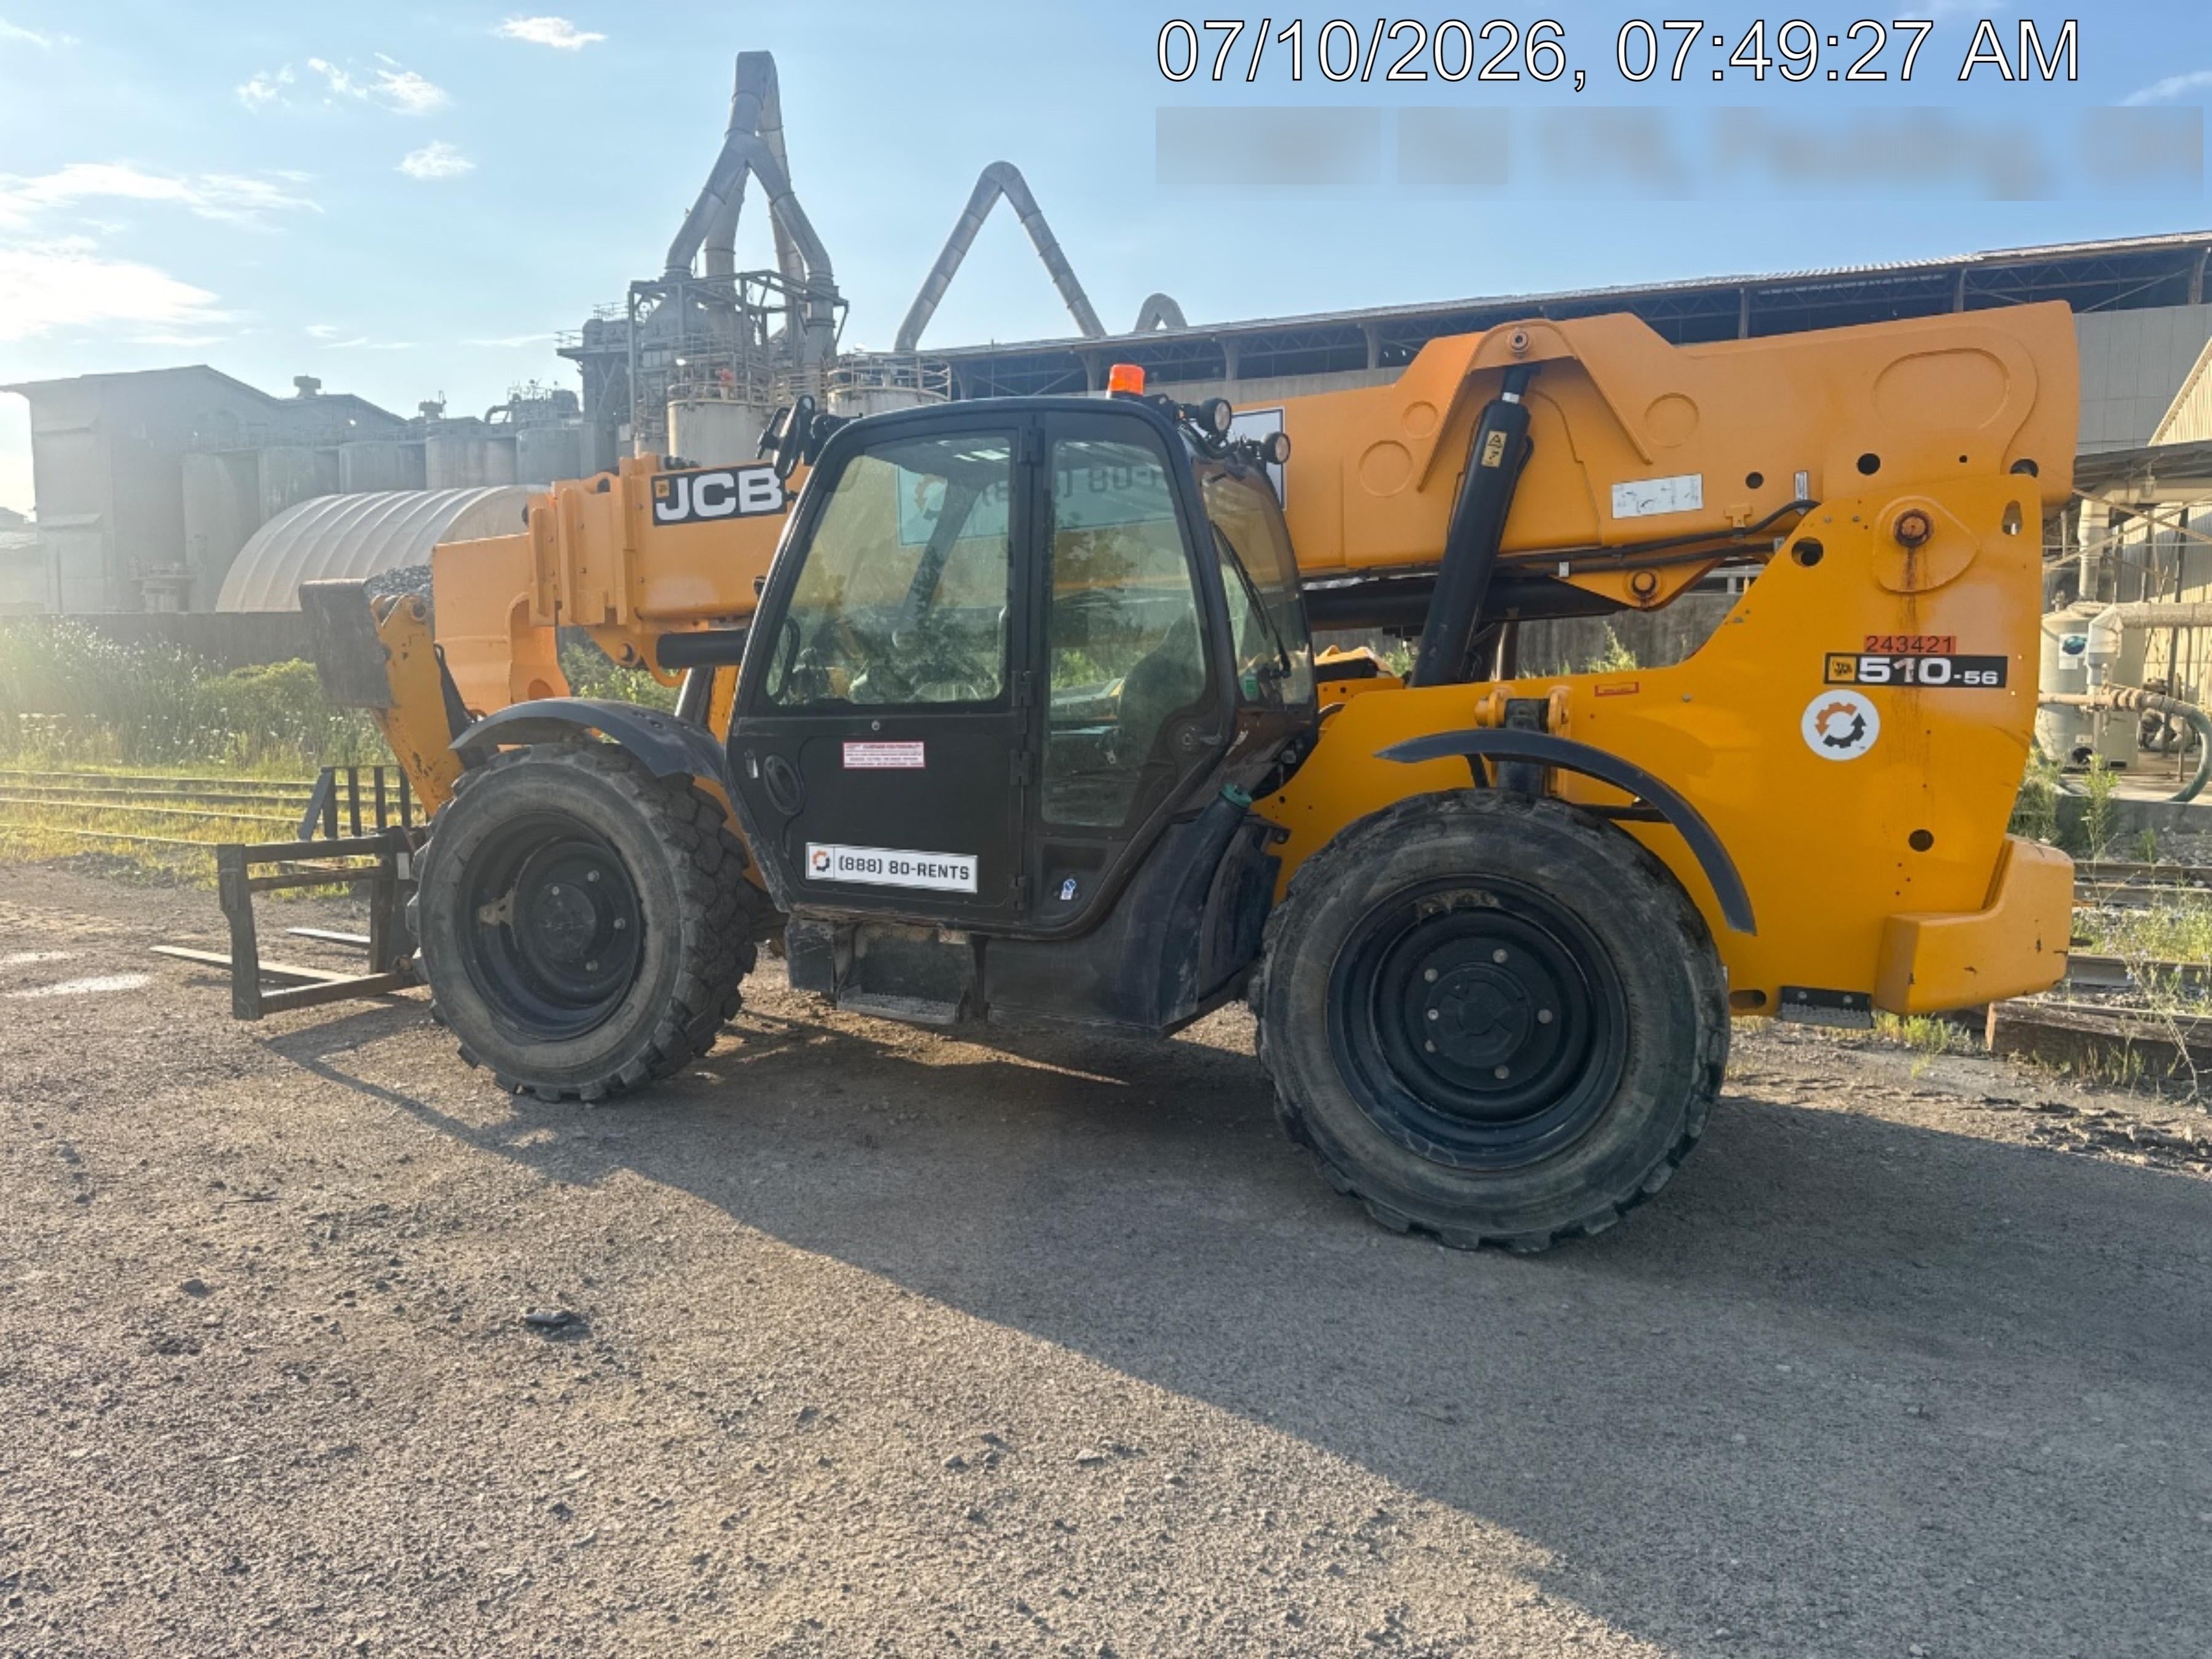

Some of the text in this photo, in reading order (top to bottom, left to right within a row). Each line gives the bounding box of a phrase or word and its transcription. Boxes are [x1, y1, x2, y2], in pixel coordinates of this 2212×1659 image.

[656, 467, 782, 520] JCB
[1865, 636, 1953, 653] 243421
[1858, 657, 1999, 684] 510-56
[838, 857, 970, 880] (888) 80-RENTS
